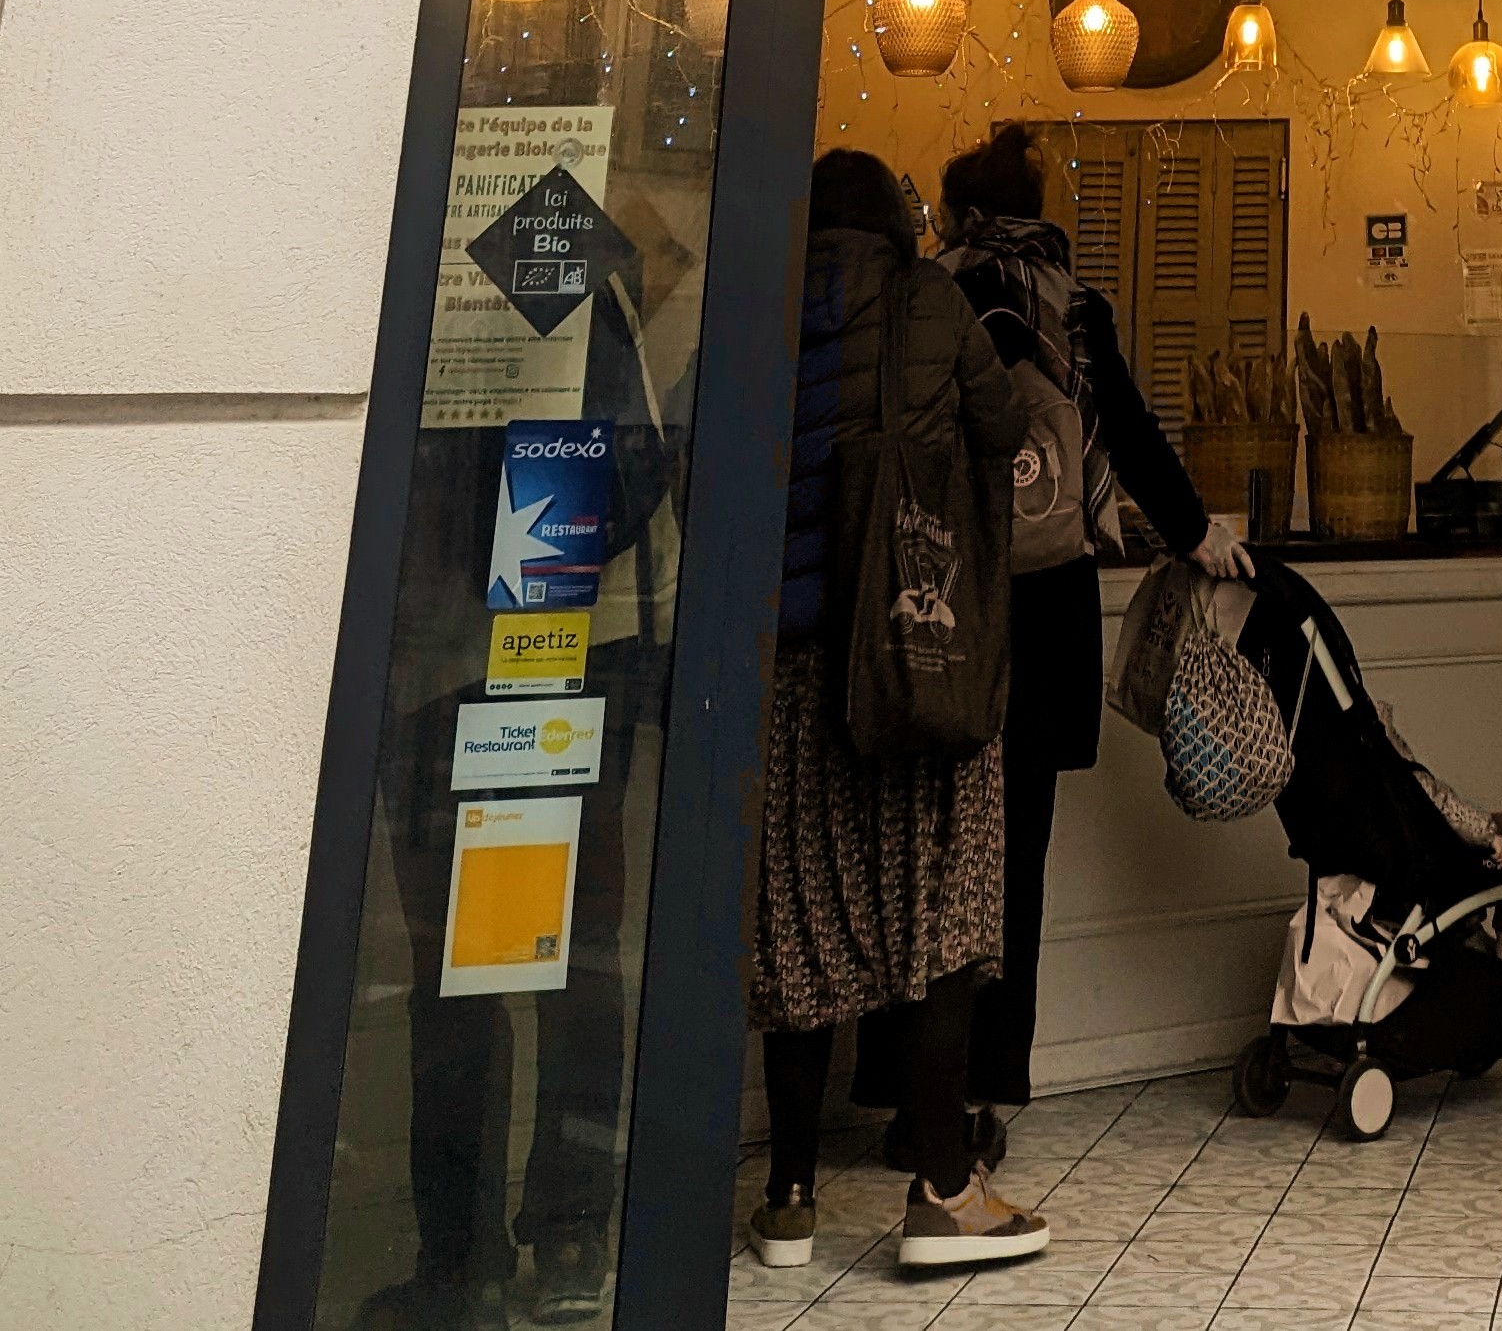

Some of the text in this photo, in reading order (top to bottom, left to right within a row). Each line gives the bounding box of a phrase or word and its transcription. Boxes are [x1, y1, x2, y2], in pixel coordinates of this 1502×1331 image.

[479, 116, 547, 136] l'équipe
[551, 117, 573, 132] de
[577, 117, 593, 132] la
[544, 188, 568, 207] Ici
[513, 211, 594, 236] produits
[533, 234, 571, 254] Bio
[511, 437, 606, 459] sodexo
[502, 628, 579, 656] apetiz
[500, 725, 536, 738] Ticket
[464, 738, 535, 754] Restaurant
